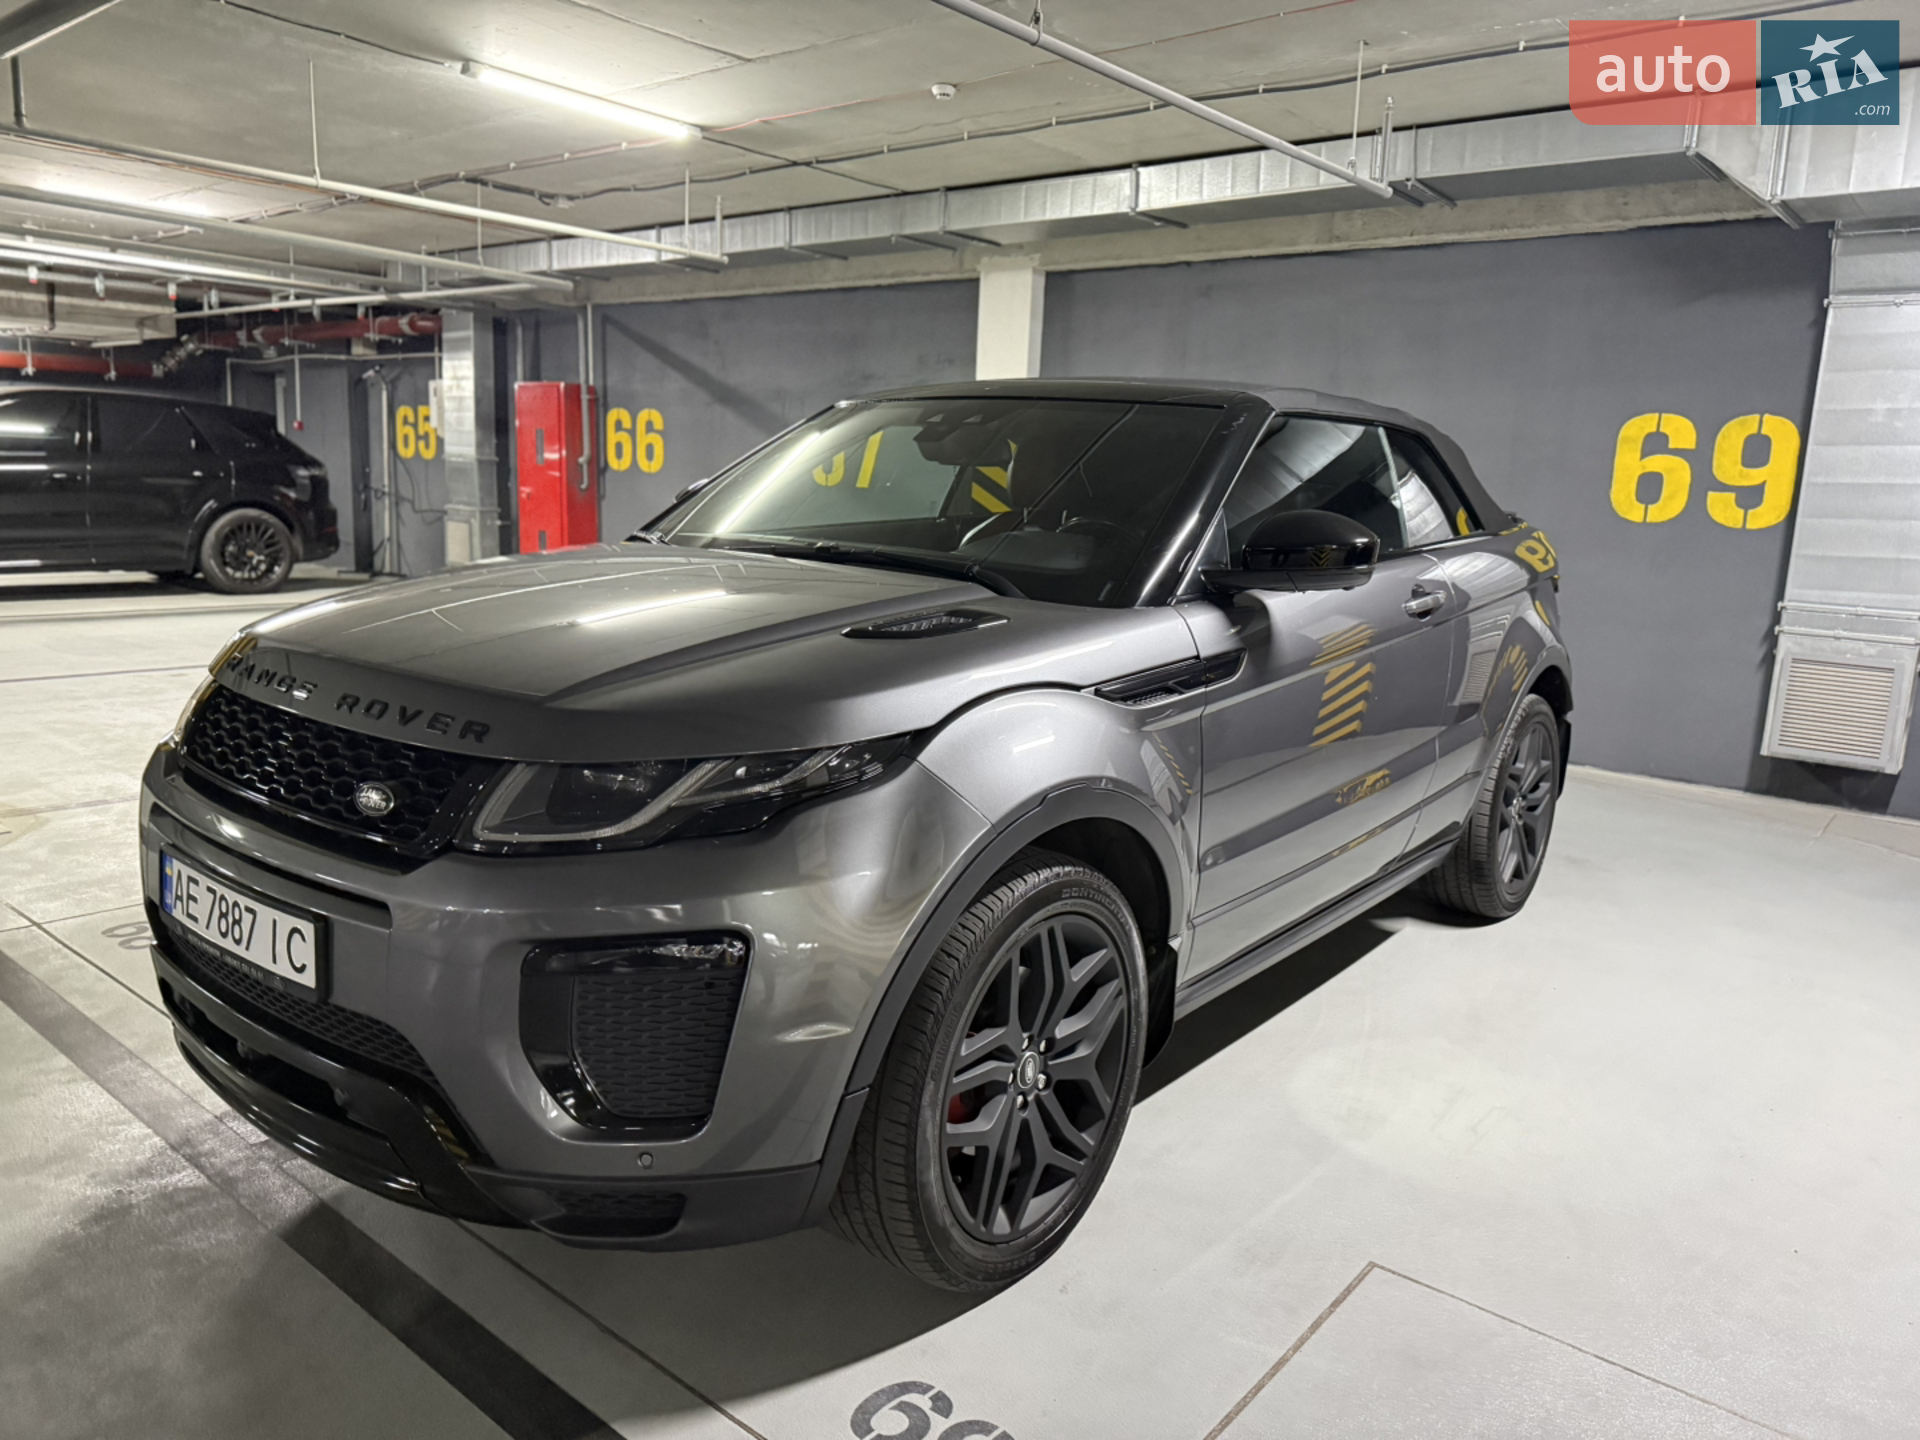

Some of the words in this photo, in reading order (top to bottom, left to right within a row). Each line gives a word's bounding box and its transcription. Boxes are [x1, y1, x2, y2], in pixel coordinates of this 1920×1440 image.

[396, 405, 438, 460] 65
[605, 407, 665, 474] 66
[1609, 412, 1801, 530] 69
[224, 651, 318, 701] RANGE
[333, 692, 491, 745] ROVER
[173, 868, 200, 925] AE
[205, 884, 258, 952] 7887
[271, 916, 308, 975] IC
